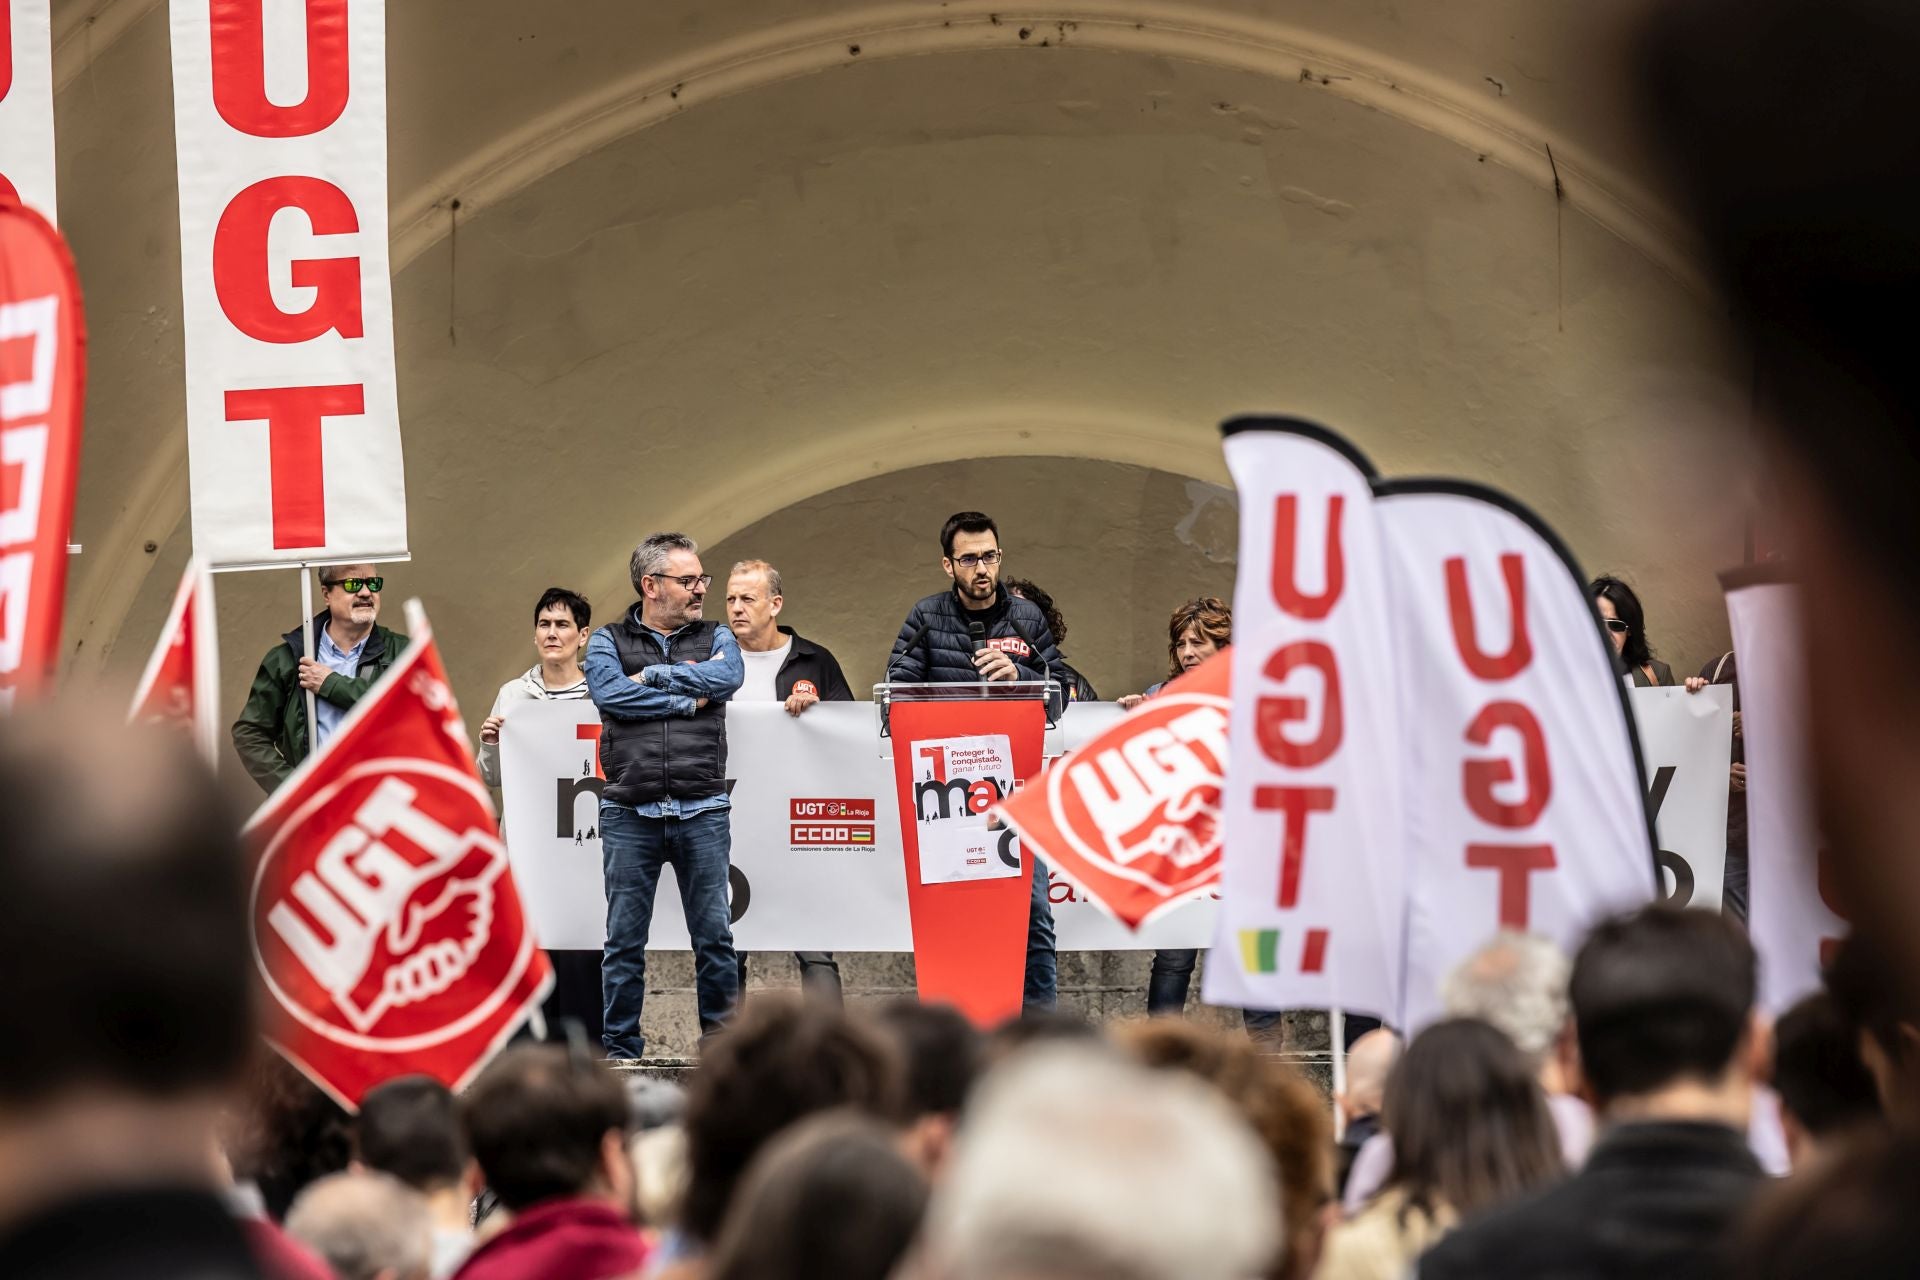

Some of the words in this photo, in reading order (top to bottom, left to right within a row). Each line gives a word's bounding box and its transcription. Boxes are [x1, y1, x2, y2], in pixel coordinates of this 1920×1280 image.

[208, 0, 365, 550] UGT
[797, 682, 815, 694] UGT
[951, 749, 985, 757] Proteger
[951, 755, 1002, 765] conquistado,
[952, 765, 975, 775] ganar
[978, 763, 1002, 771] futuro
[1068, 706, 1229, 838] UGT
[795, 803, 825, 815] UGT
[794, 827, 848, 841] CCOO
[267, 776, 462, 992] UGT
